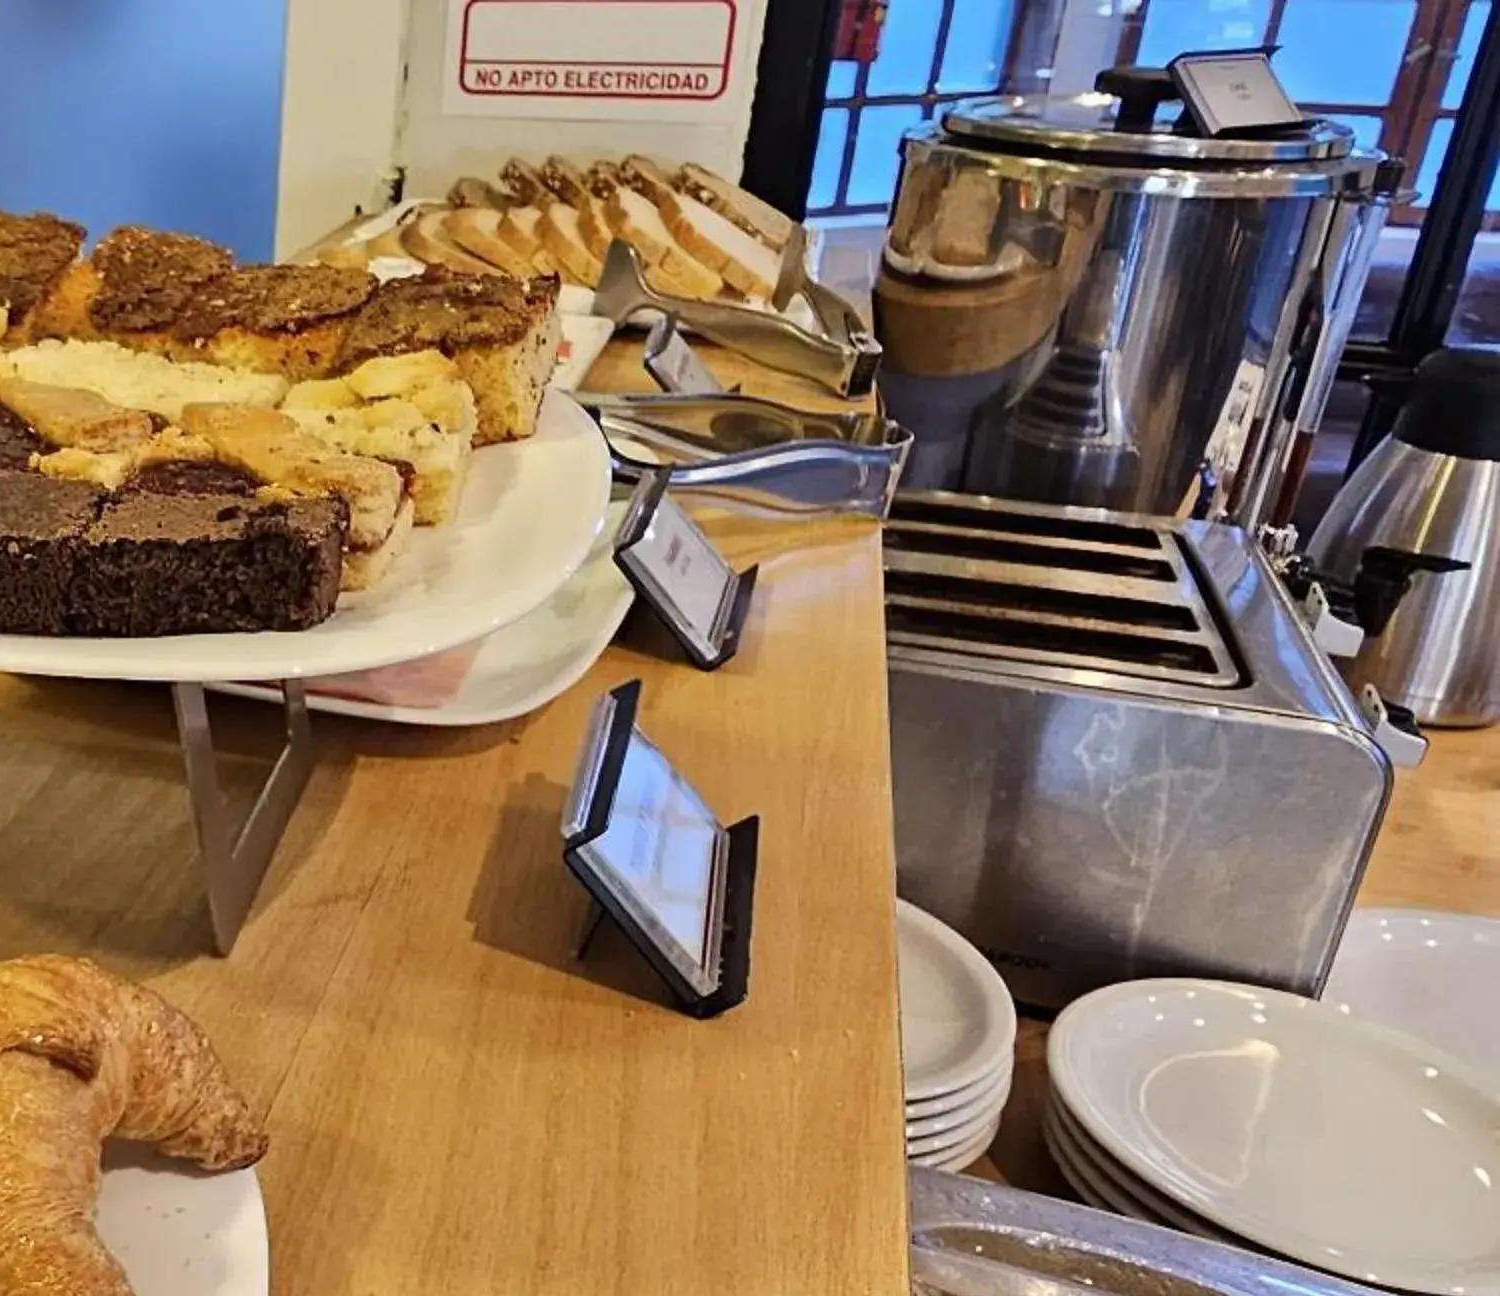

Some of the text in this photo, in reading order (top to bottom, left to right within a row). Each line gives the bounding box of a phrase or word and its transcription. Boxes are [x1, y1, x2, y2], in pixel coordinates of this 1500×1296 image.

[474, 70, 708, 90] NO APTO ELECTRICIDAD
